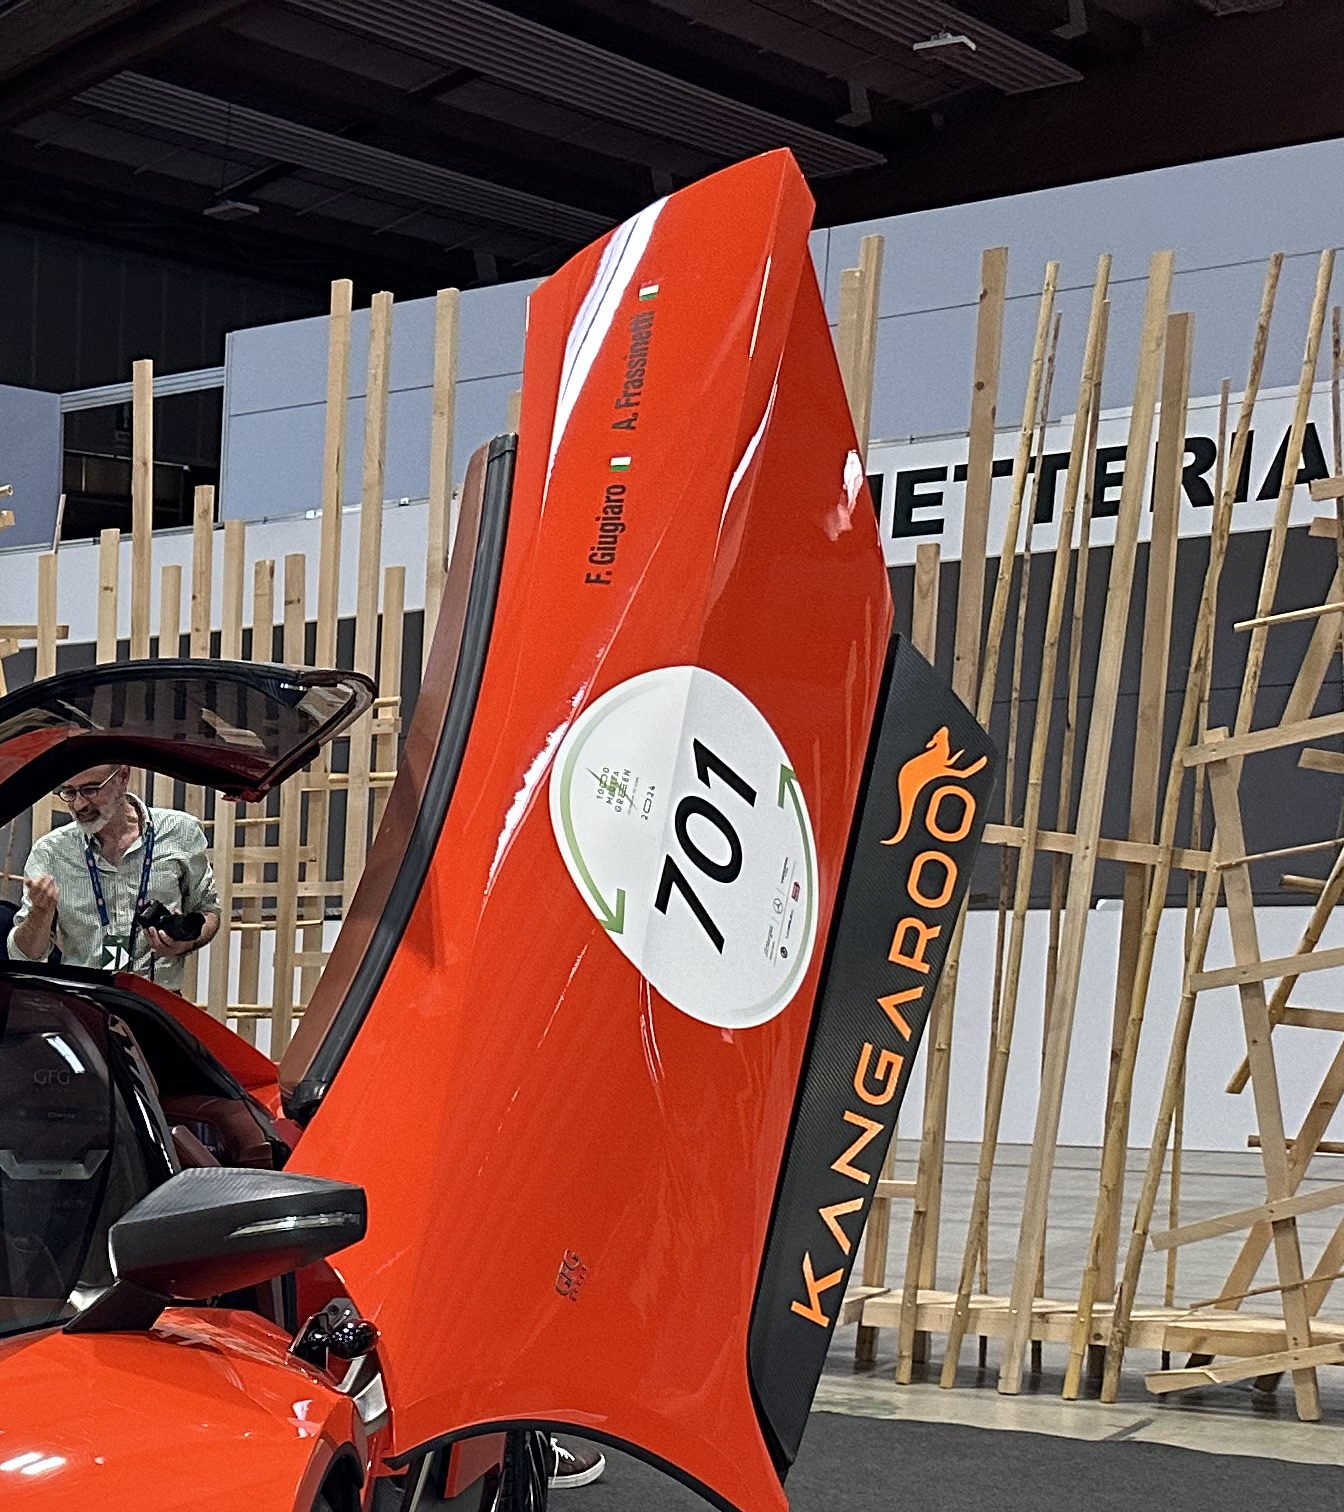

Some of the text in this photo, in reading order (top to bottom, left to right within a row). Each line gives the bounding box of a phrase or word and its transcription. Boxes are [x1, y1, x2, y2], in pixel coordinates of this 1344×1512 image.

[611, 411, 639, 432] A.
[588, 484, 627, 567] Giugiaro
[584, 570, 612, 586] F.
[653, 738, 758, 955] 701
[33, 1068, 70, 1085] GFG
[790, 784, 977, 1328] KANGAROO
